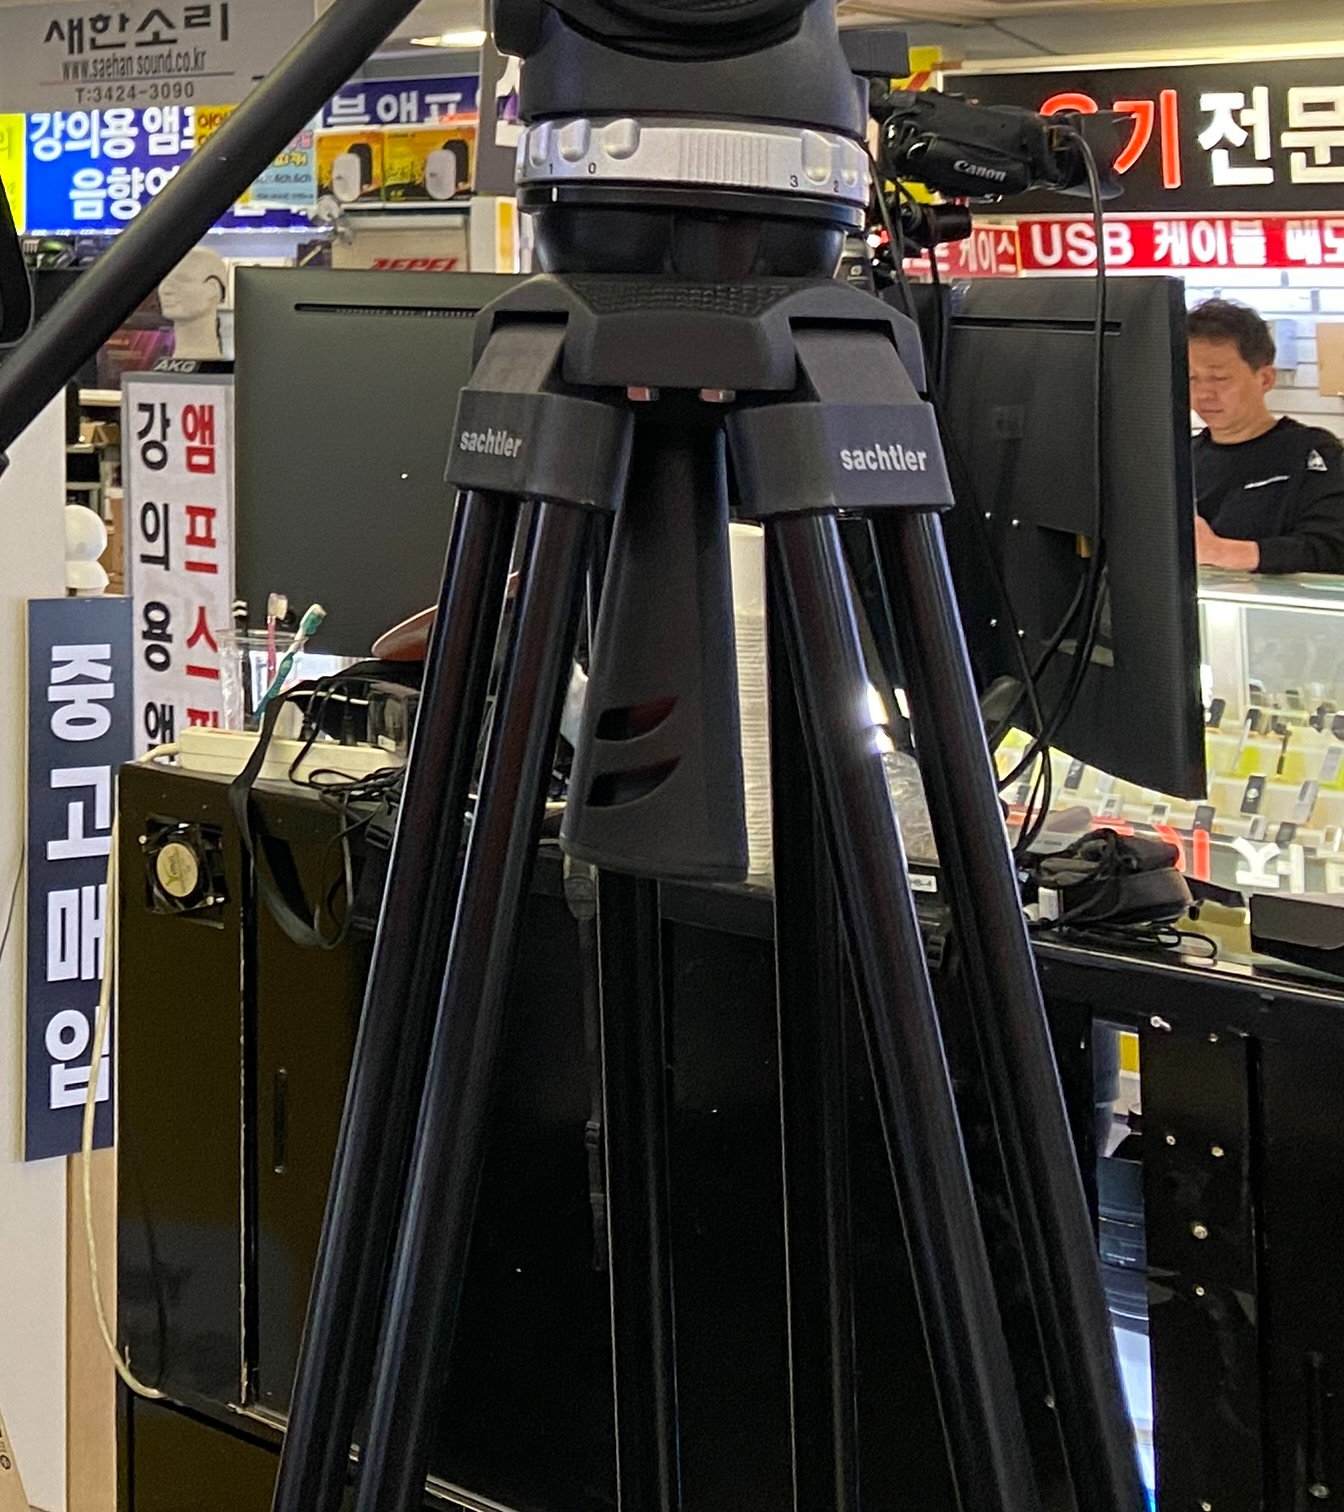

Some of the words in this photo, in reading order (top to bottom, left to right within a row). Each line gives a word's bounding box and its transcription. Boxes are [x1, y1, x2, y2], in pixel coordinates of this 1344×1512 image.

[43, 2, 230, 55] 새한소리
[74, 81, 196, 104] T:3424-3090
[29, 107, 140, 162] 강의용
[1040, 92, 1182, 189] 기
[953, 159, 1008, 183] Canon
[1031, 223, 1135, 267] USB
[459, 427, 523, 458] sachtler
[839, 444, 927, 472] sachtler
